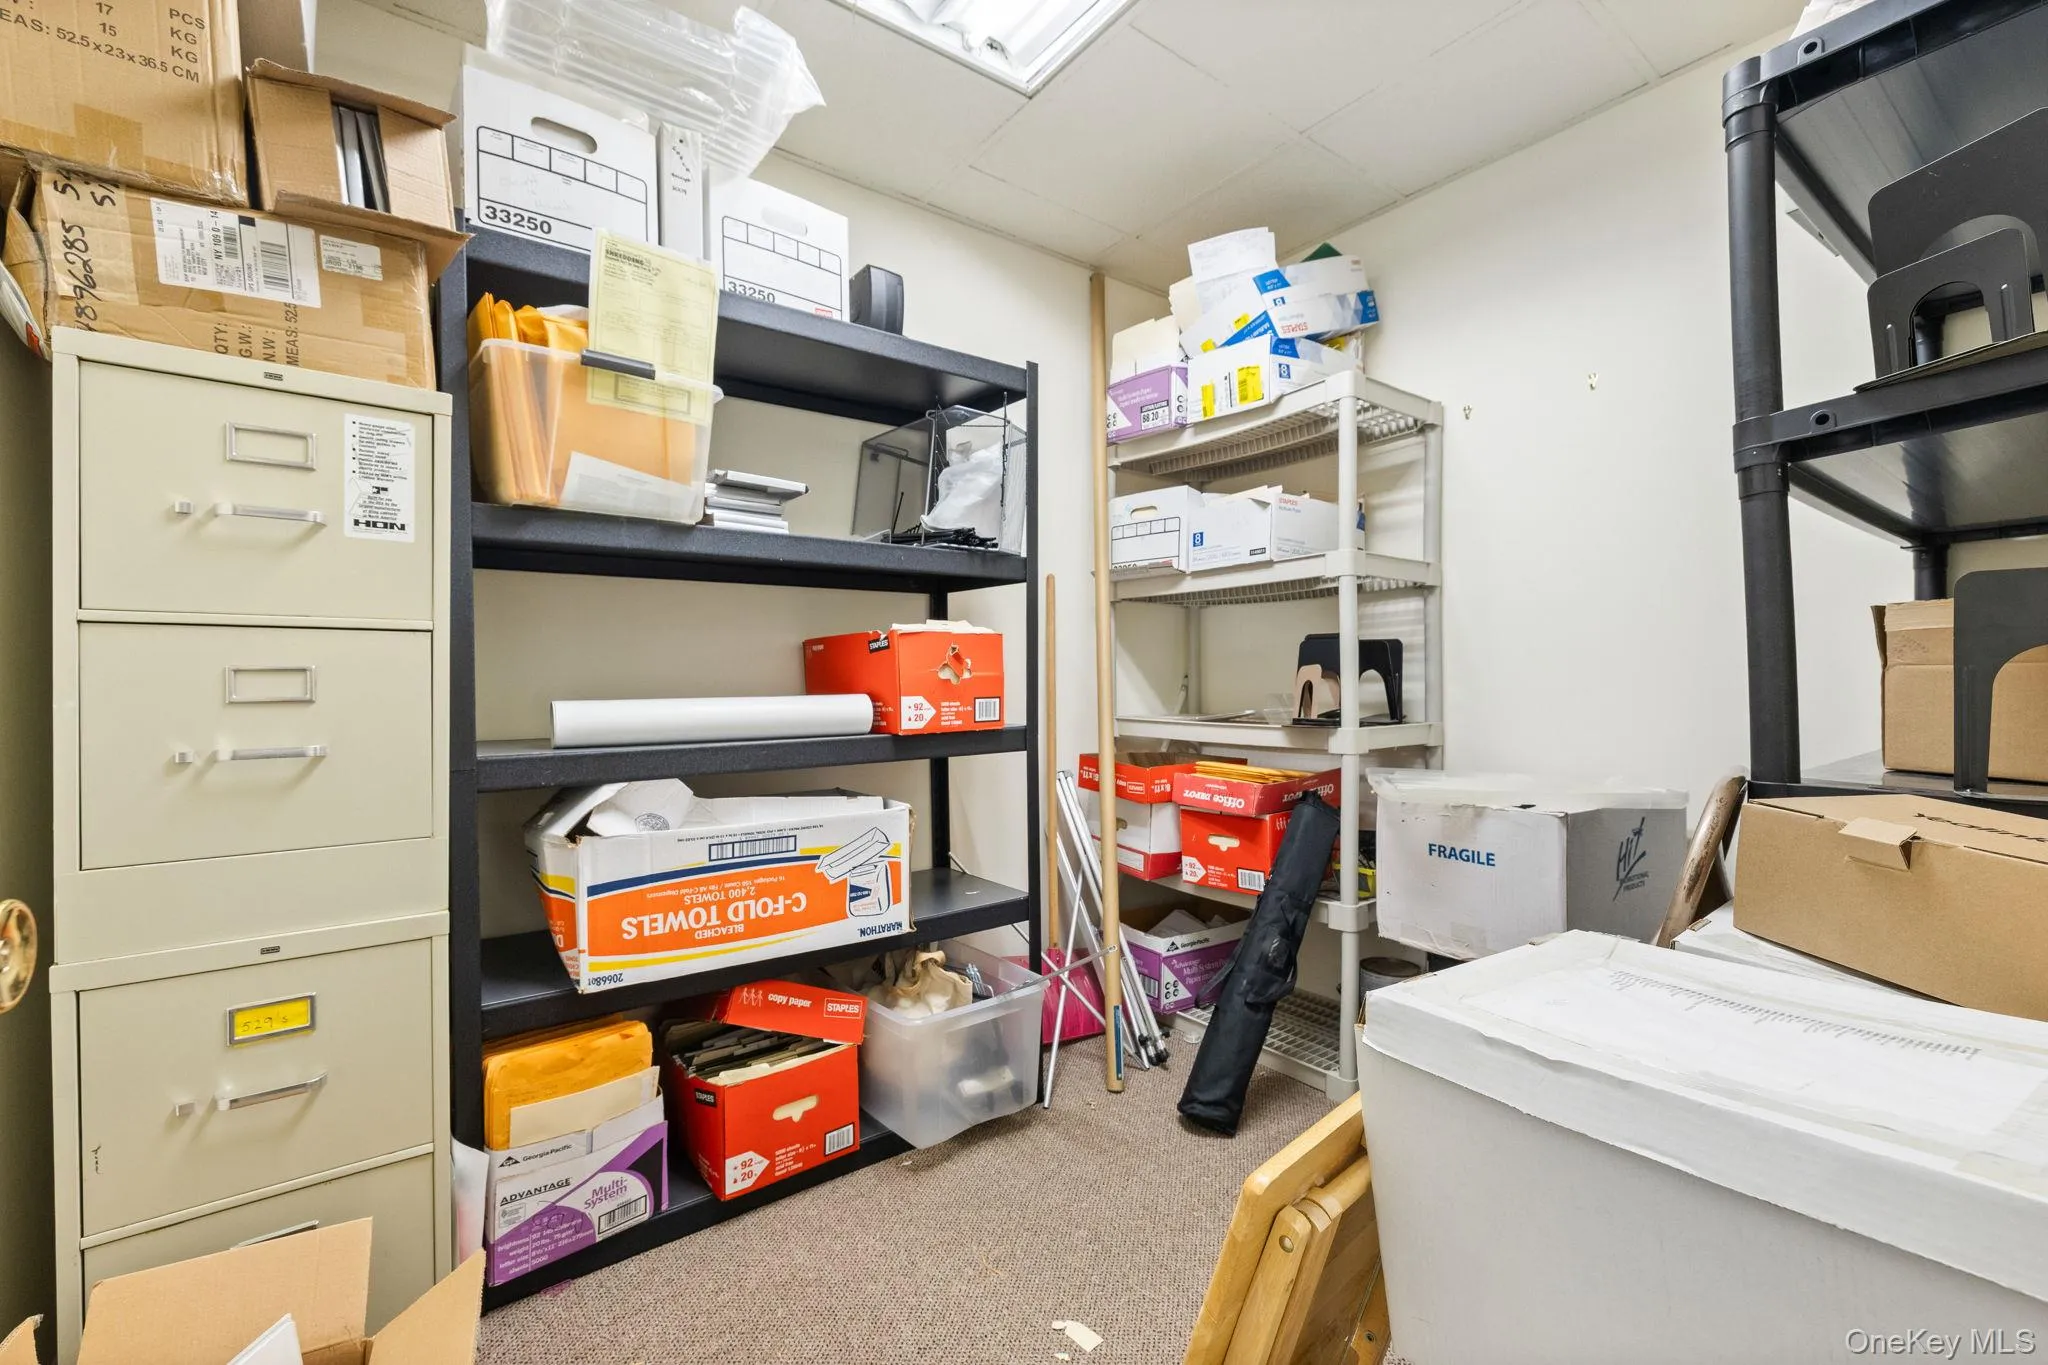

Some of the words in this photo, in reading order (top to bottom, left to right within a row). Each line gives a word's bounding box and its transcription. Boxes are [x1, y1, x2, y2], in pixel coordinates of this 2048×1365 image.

[169, 8, 206, 30] PCS
[99, 22, 118, 37] 15
[170, 27, 197, 45] KG
[171, 46, 198, 64] KG
[172, 66, 200, 83] CM
[484, 205, 553, 236] 33250
[214, 250, 223, 260] NY
[727, 280, 776, 304] 33250
[215, 321, 229, 354] QTY:
[1281, 364, 1288, 376] 8
[353, 518, 406, 531] HON
[1194, 533, 1202, 544] 8
[869, 639, 889, 650] STAPLES
[913, 702, 924, 711] 92
[914, 713, 924, 722] 20
[1183, 789, 1211, 801] DEPOT
[1213, 794, 1245, 809] Office
[1428, 842, 1496, 867] FRAGILE
[684, 892, 726, 905] TOWELS
[729, 886, 756, 900] 2,400
[727, 892, 807, 923] C-FOLD
[621, 906, 721, 940] TOWELS
[694, 923, 745, 940] BLEACHED
[768, 993, 787, 1005] copy
[789, 997, 812, 1008] paper
[827, 1003, 859, 1013] STAPLES
[695, 1091, 714, 1103] STAPLES
[740, 1158, 753, 1168] 92
[741, 1170, 753, 1182] 20
[500, 1177, 571, 1205] ADVANTAGE
[591, 1177, 628, 1198] Multi-
[584, 1185, 628, 1211] System
